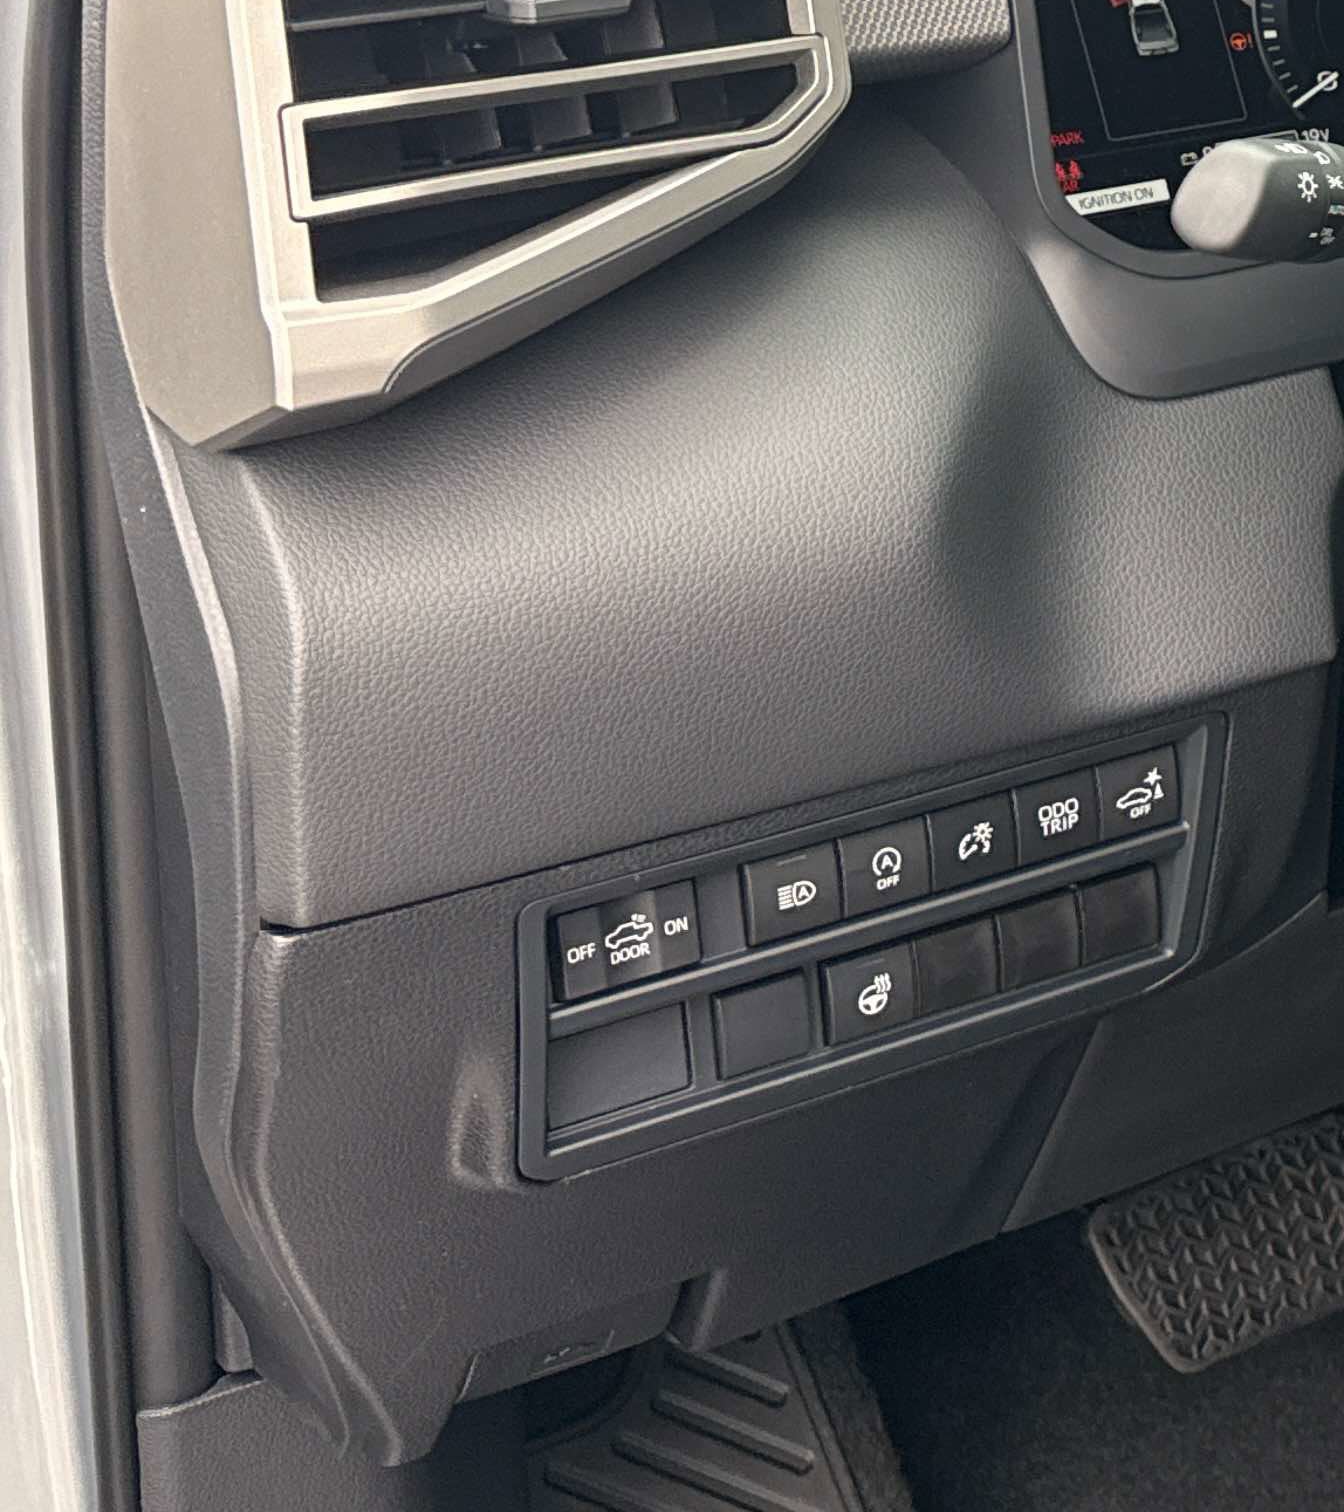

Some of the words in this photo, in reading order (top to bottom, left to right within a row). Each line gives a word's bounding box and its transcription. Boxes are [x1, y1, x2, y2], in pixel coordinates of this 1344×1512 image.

[1078, 190, 1133, 210] IGNITION
[1134, 187, 1154, 201] ON
[1037, 797, 1080, 822] ODO
[1128, 802, 1152, 819] OFF
[1038, 813, 1079, 836] TRIP
[875, 873, 900, 891] OFF
[566, 941, 597, 965] OFF
[610, 941, 651, 965] DOOR
[663, 915, 689, 937] ON
